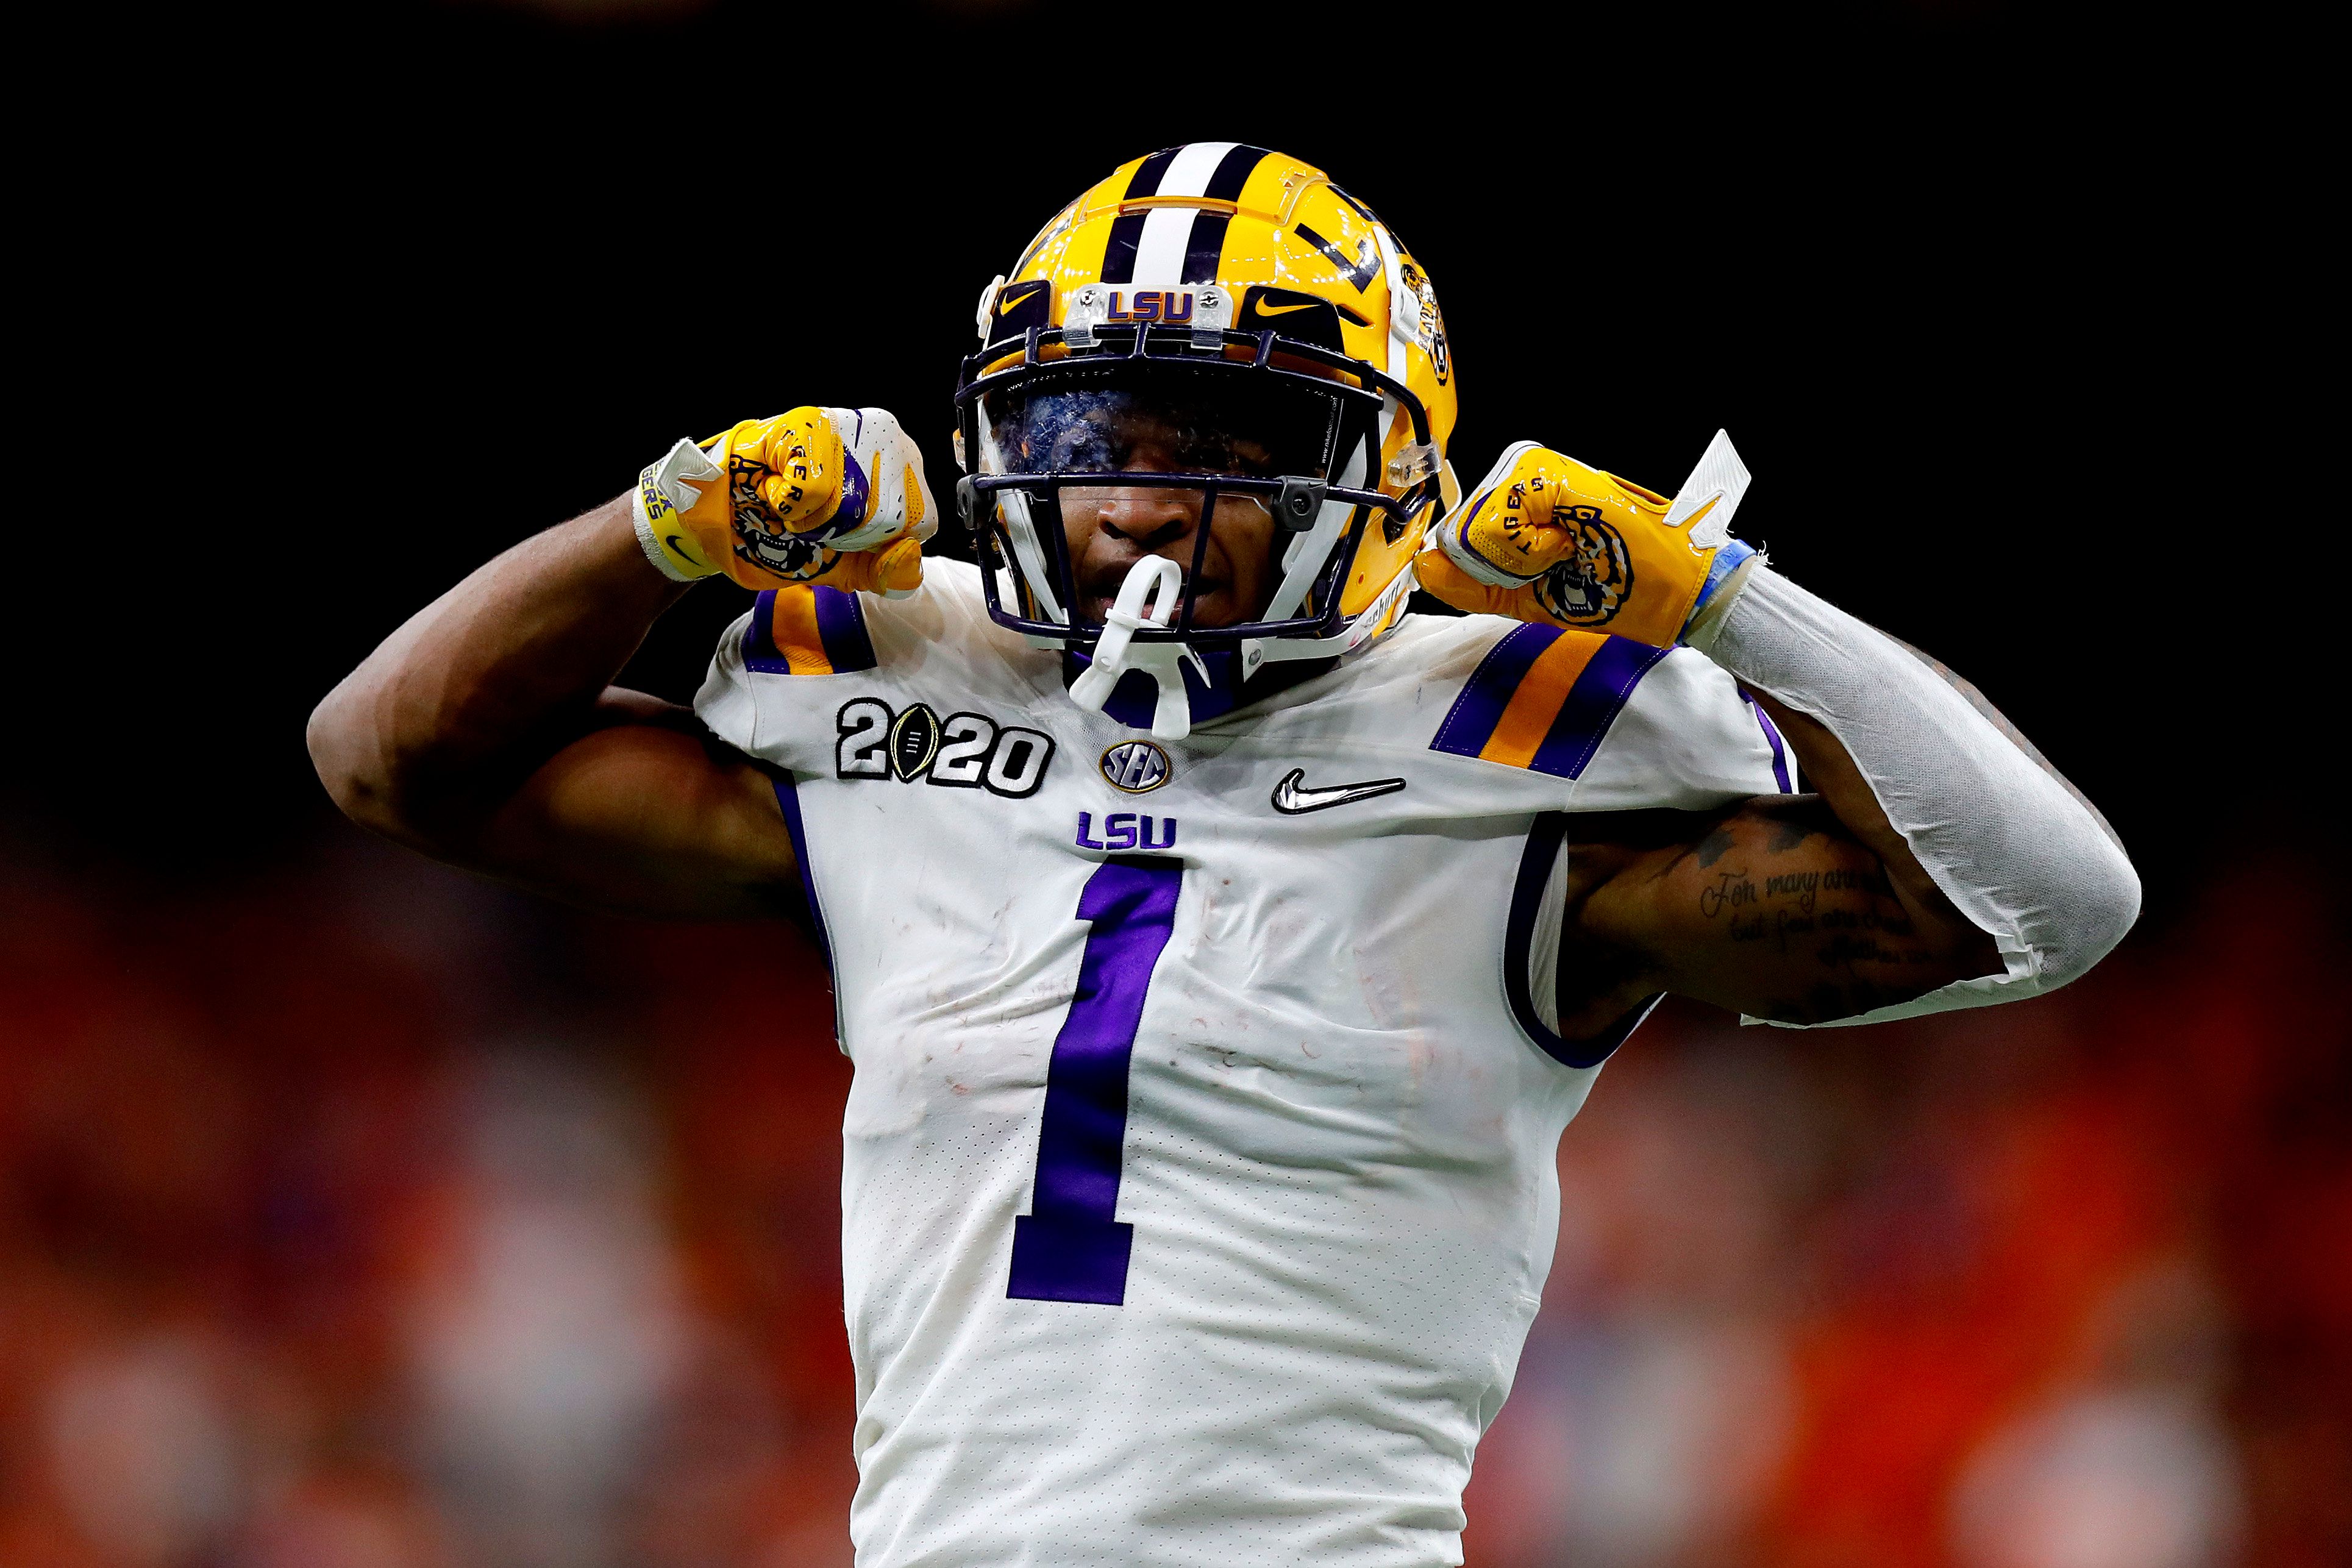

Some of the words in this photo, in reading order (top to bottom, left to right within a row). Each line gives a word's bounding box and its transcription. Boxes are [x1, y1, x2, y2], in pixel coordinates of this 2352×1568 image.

[1108, 291, 1193, 324] LSU
[1103, 743, 1166, 783] SEC
[1075, 811, 1177, 850] LSU
[1005, 853, 1184, 1306] 1
